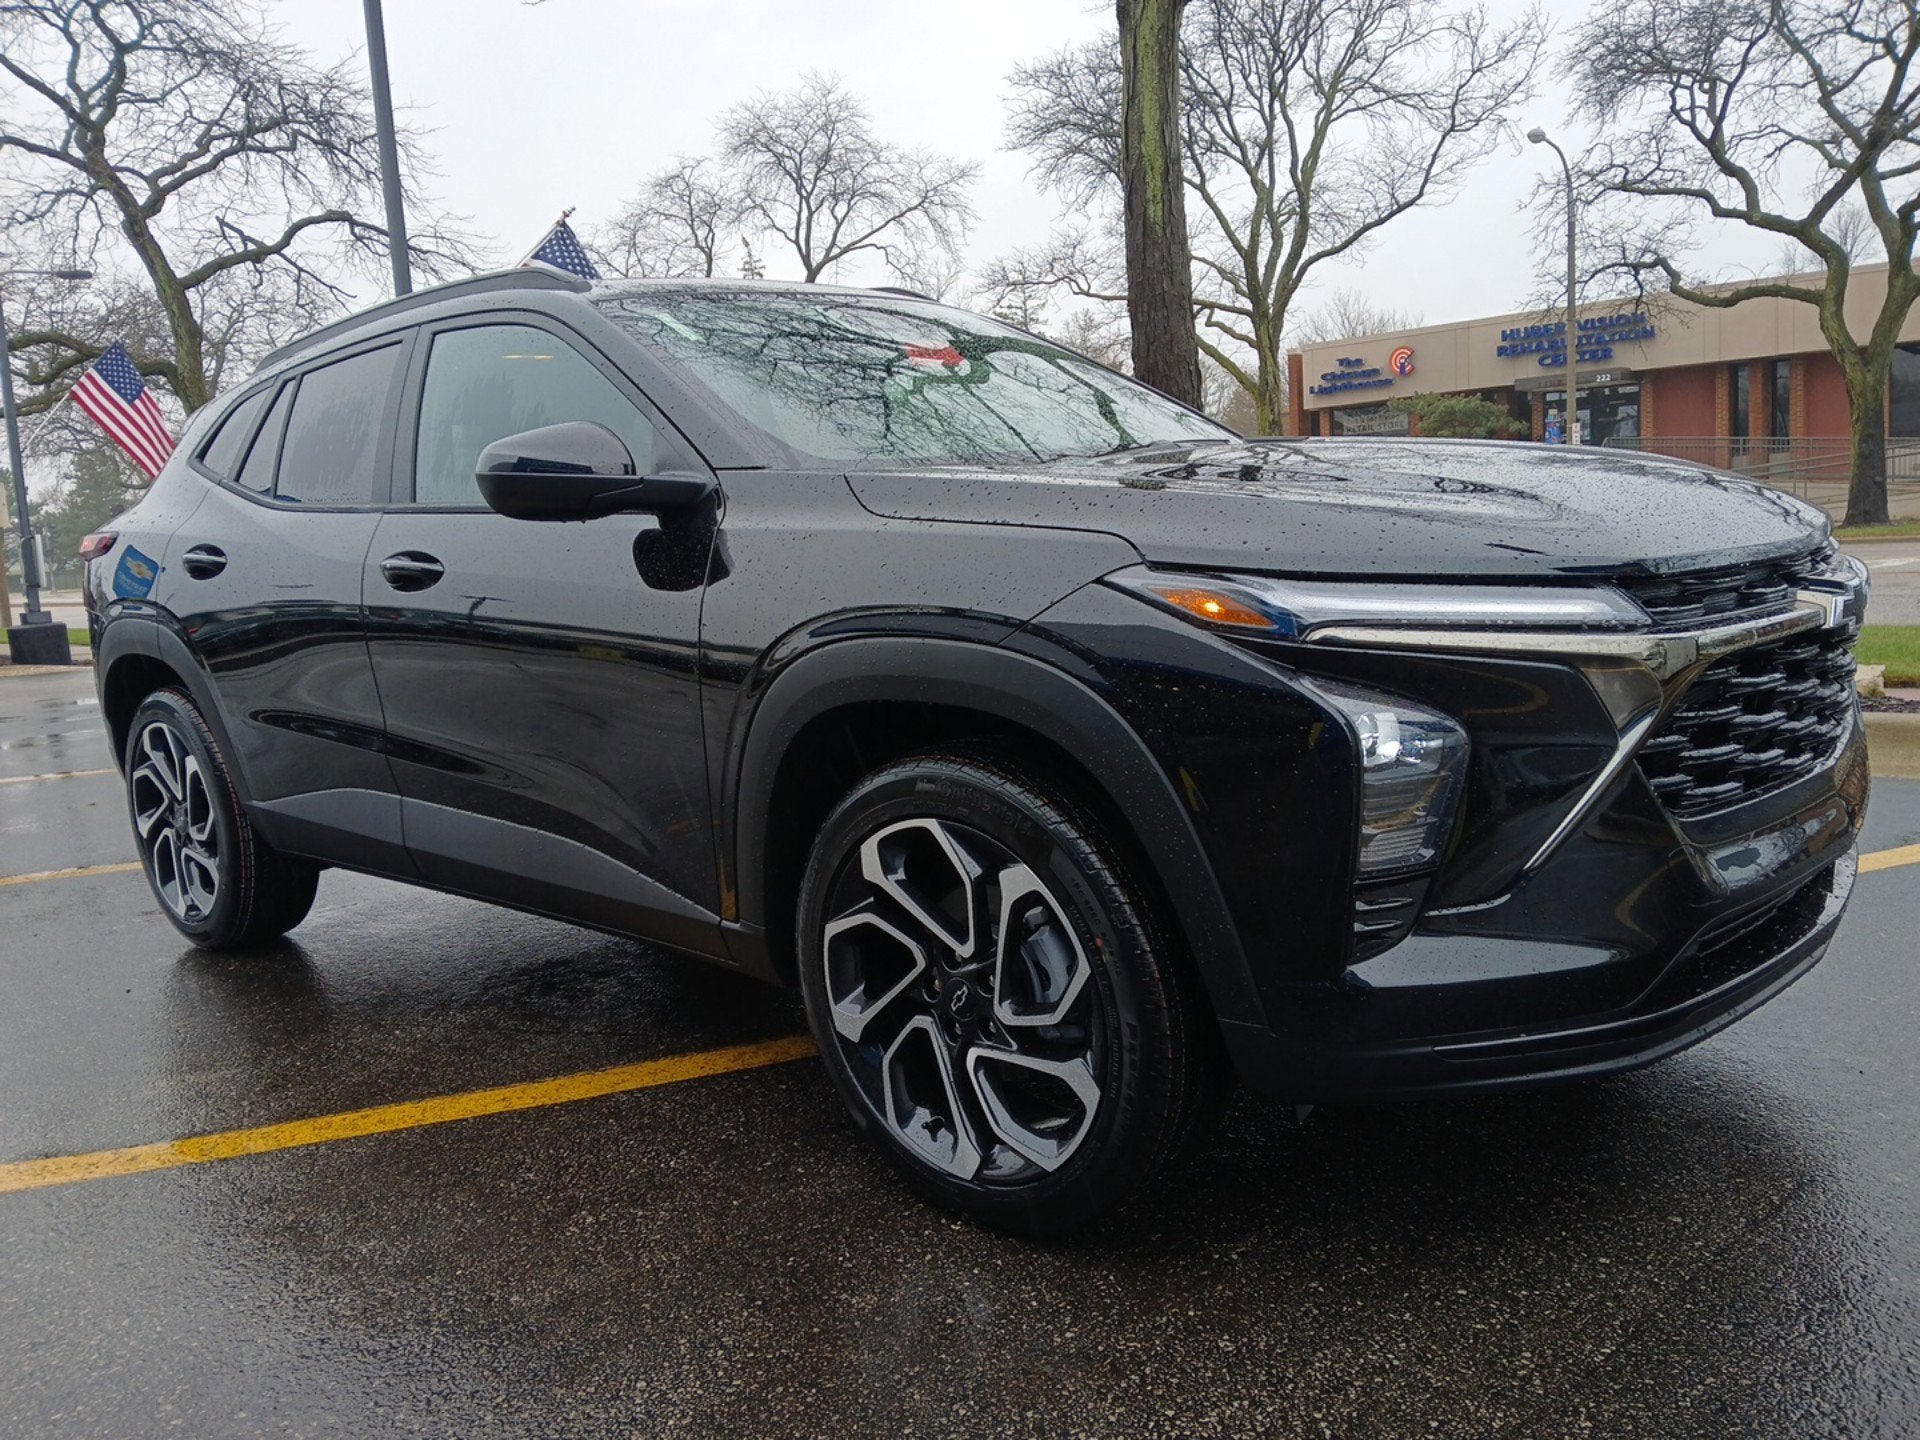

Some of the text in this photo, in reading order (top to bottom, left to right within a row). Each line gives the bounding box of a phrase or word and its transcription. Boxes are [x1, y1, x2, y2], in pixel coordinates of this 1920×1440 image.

[1501, 311, 1646, 342] HUBER VISION
[1496, 325, 1656, 357] REHABIITATION
[1336, 357, 1365, 368] The
[1538, 347, 1613, 367] CETER
[1320, 367, 1381, 381] Chicago
[1596, 374, 1612, 382] 222
[1309, 378, 1394, 395] Lighthouse
